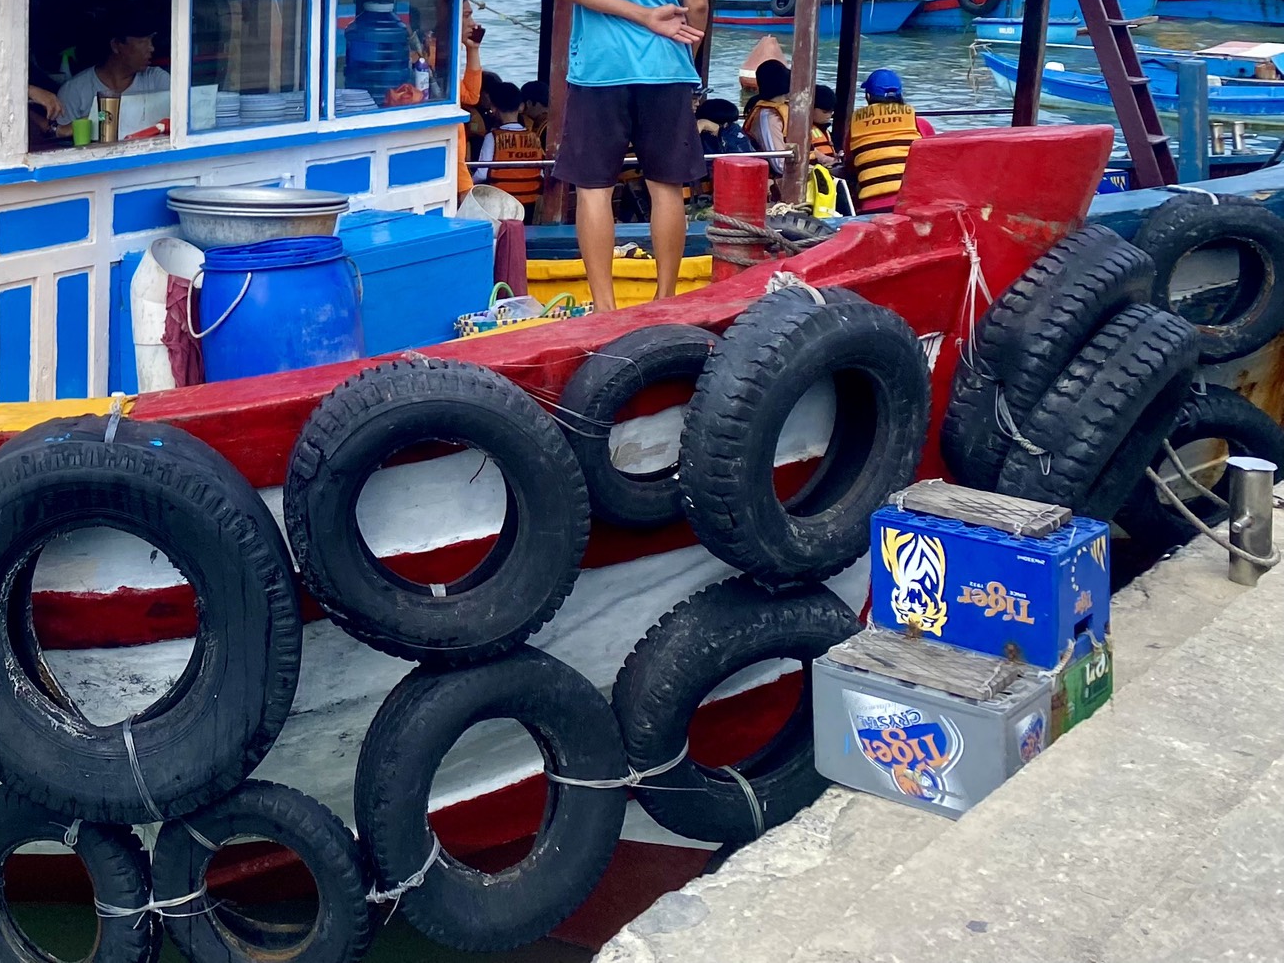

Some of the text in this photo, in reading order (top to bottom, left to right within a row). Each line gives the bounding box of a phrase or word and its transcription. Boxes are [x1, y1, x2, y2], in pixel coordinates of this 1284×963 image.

[855, 103, 912, 121] NHA TRANG
[864, 117, 902, 126] TOUR
[957, 581, 1035, 624] Tiger
[861, 728, 951, 768] Tiger
